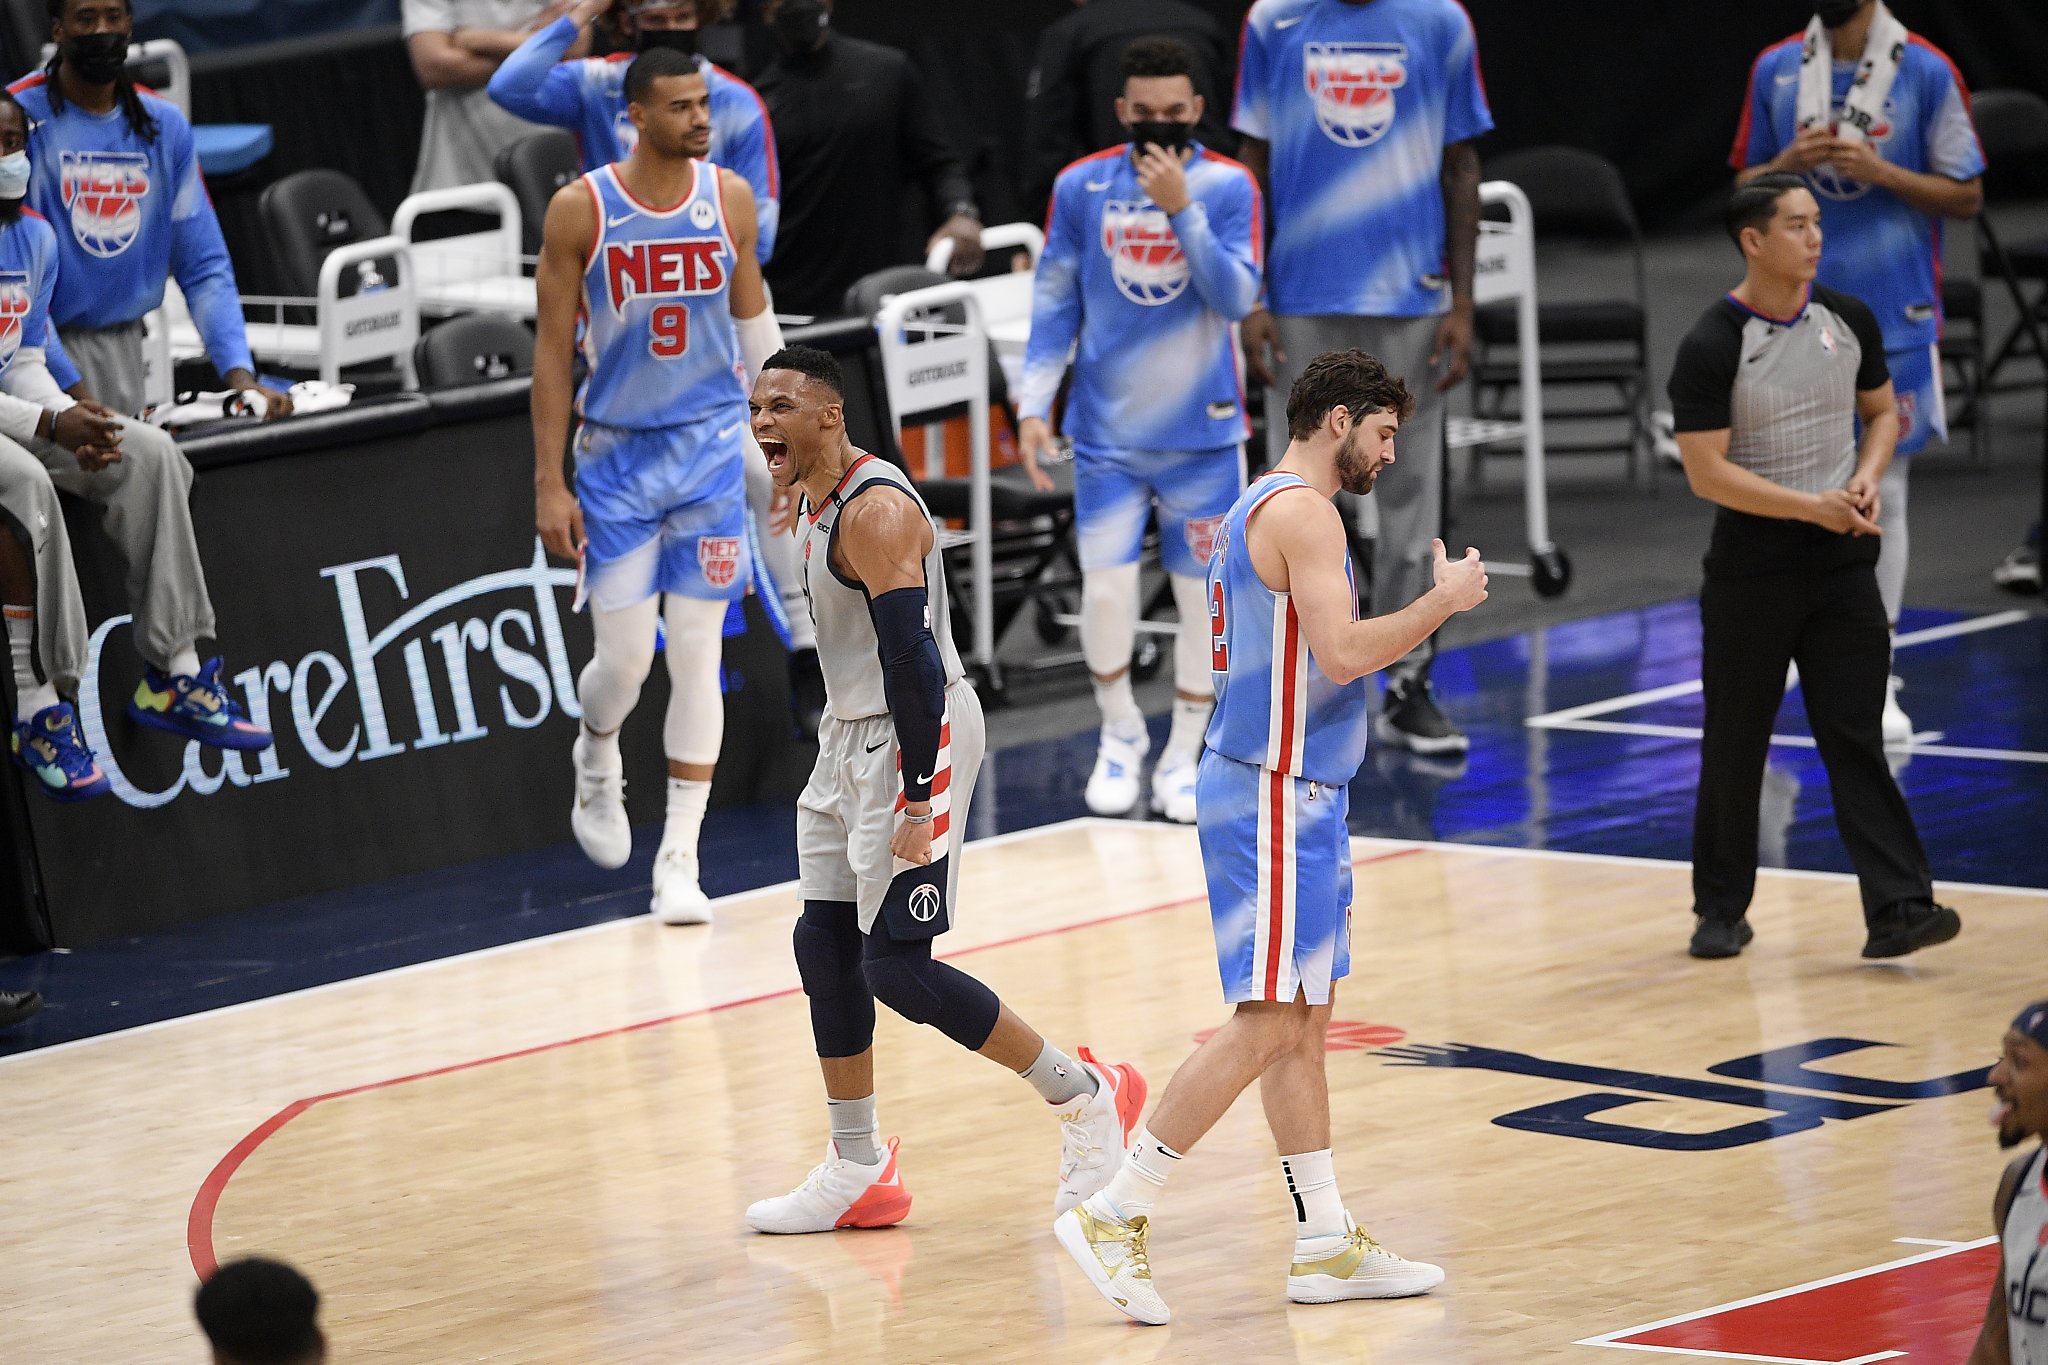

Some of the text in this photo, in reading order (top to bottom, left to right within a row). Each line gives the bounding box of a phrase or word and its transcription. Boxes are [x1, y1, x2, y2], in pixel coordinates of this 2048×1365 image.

[60, 151, 151, 211] NETS
[604, 236, 728, 322] NETS
[649, 302, 691, 360] 9
[698, 537, 741, 565] NETS
